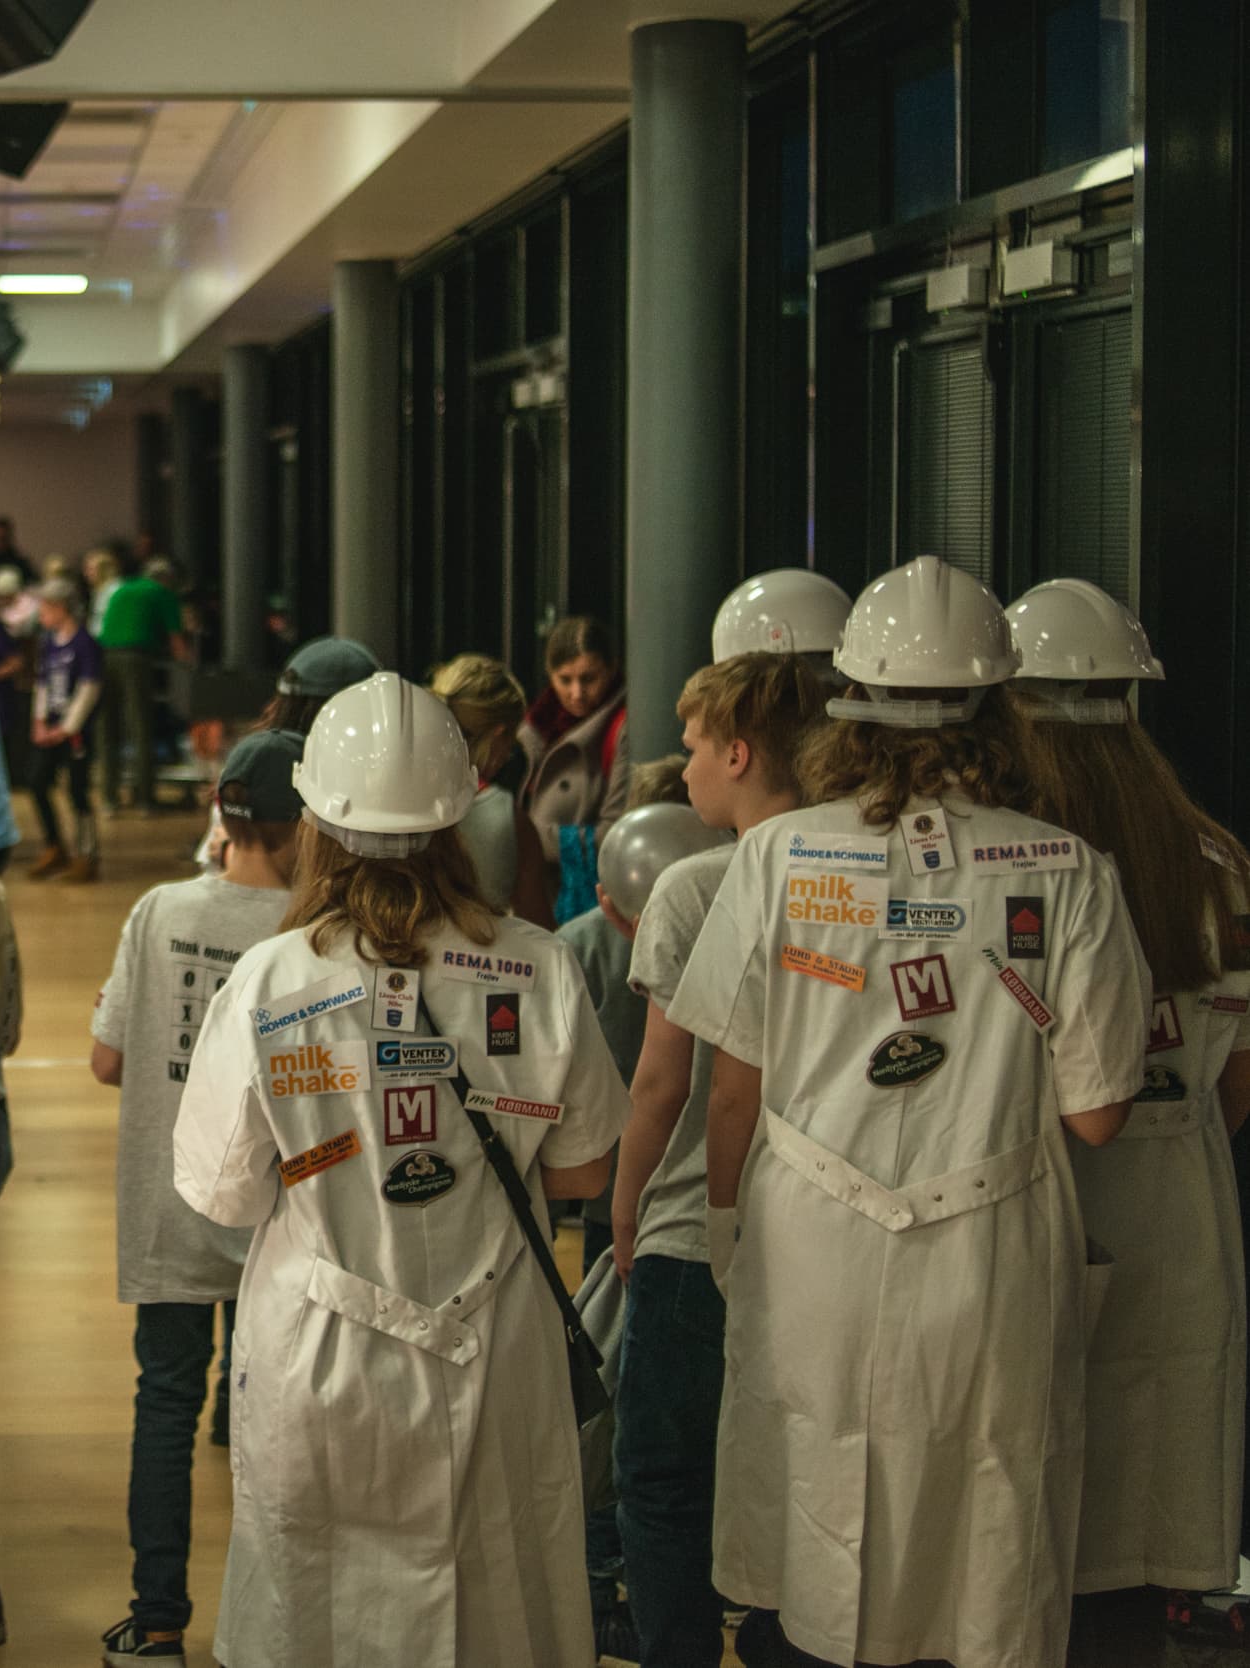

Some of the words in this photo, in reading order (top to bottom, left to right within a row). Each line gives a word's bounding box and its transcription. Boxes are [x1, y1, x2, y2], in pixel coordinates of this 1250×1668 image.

[789, 848, 824, 859] ROHDE
[833, 851, 886, 862] SCHWARZ
[973, 845, 1027, 862] REMA
[1031, 841, 1071, 858] 1000
[789, 875, 855, 901] milk
[787, 898, 877, 926] shake
[909, 910, 956, 920] VENTEK
[170, 939, 199, 956] Think
[204, 946, 240, 964] outsid
[784, 946, 811, 960] LUND
[1012, 941, 1040, 949] HUSE
[443, 950, 492, 972] REMA
[496, 958, 533, 977] 1000
[258, 1012, 300, 1035] ROHDE
[298, 1008, 307, 1019] &
[307, 986, 365, 1016] SCHWARZ
[270, 1045, 335, 1074] milk
[402, 1048, 446, 1059] VENTEK
[271, 1069, 358, 1097] shake
[468, 1094, 495, 1107] Min
[498, 1098, 559, 1119] KØBMAND
